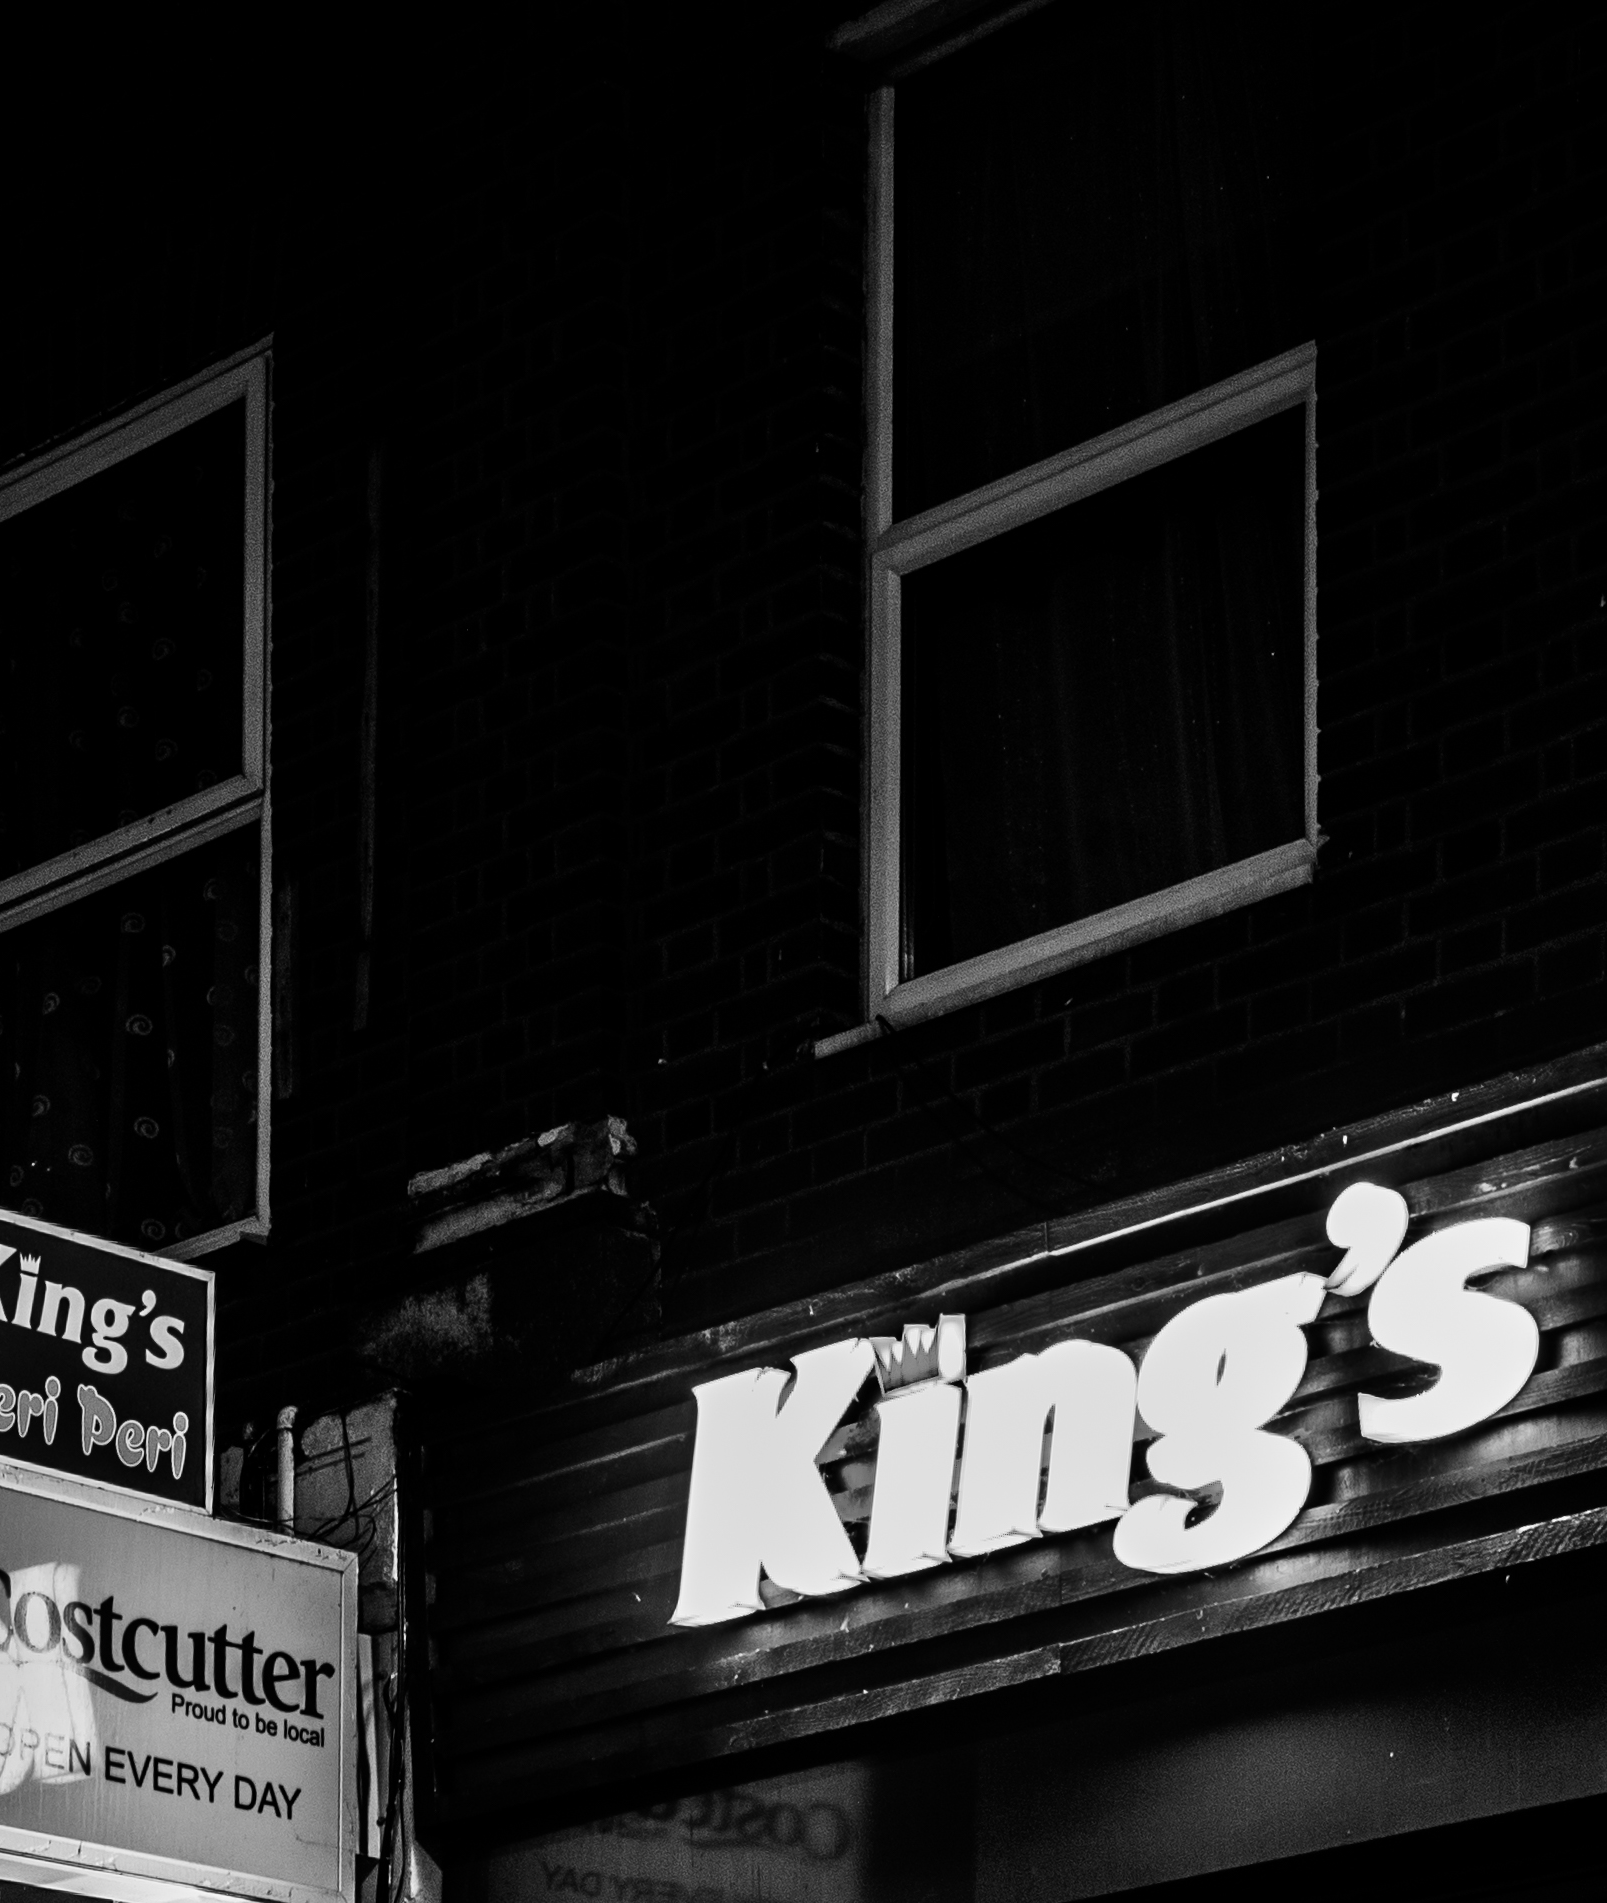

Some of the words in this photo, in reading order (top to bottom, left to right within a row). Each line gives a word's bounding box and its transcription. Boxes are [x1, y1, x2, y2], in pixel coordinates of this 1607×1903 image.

[77, 1383, 190, 1480] Peri
[667, 1182, 1540, 1627] King's
[171, 1692, 226, 1726] Proud
[232, 1705, 249, 1729] to
[254, 1708, 278, 1736] be
[283, 1713, 326, 1748] local
[104, 1748, 226, 1806] EVERY
[233, 1779, 302, 1822] DAY
